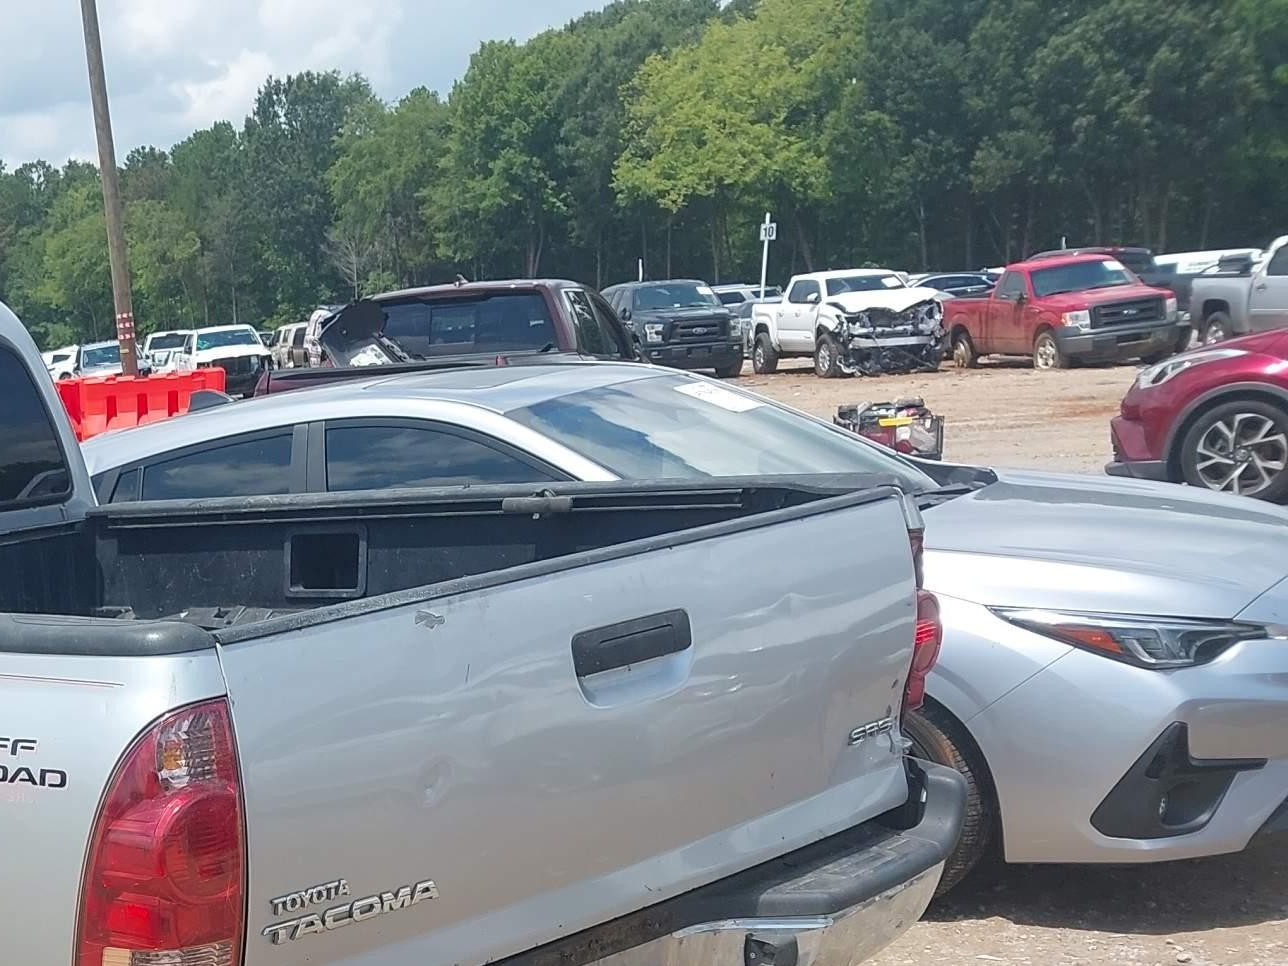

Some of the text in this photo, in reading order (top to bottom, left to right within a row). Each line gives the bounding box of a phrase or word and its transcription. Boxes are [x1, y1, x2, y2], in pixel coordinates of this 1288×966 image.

[763, 226, 774, 238] 10
[261, 878, 440, 946] TACOMA
[270, 878, 352, 916] TOYOTA
